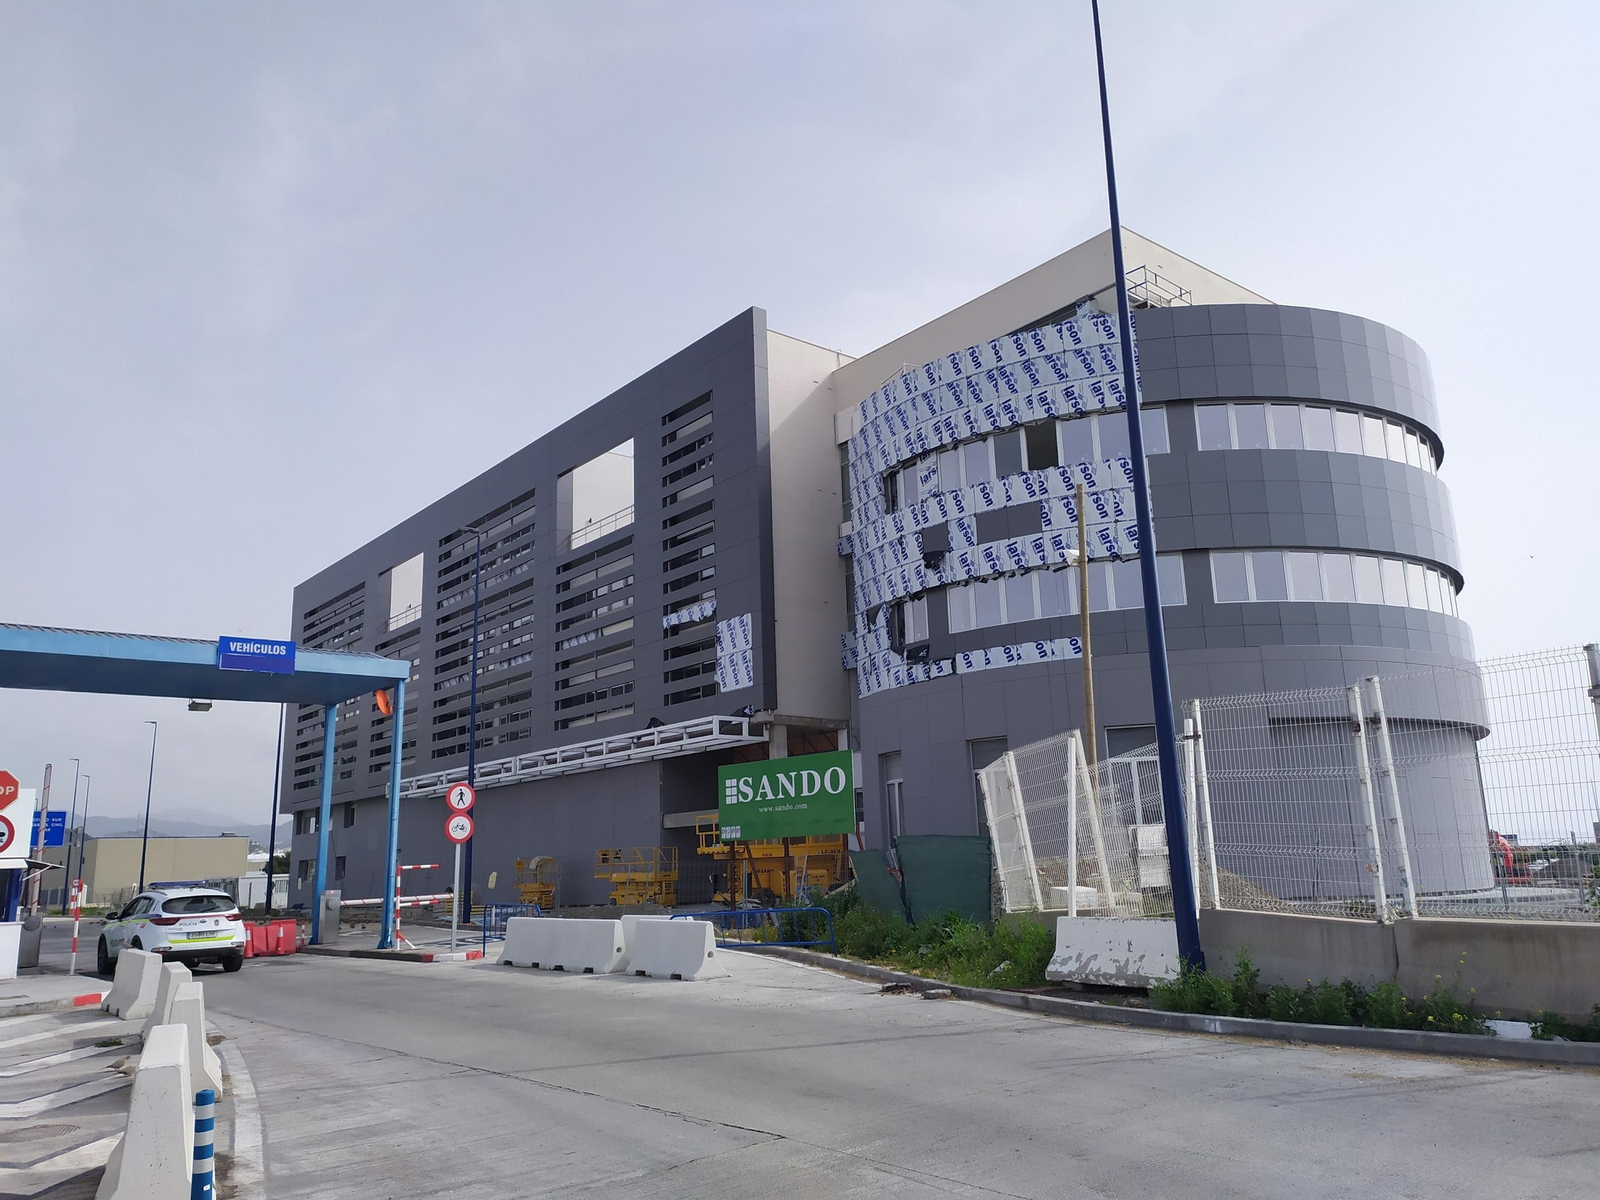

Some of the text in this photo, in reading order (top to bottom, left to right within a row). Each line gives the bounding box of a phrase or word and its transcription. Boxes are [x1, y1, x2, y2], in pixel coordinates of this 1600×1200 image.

[229, 642, 286, 656] VEHÍCULOS
[738, 766, 846, 802] SANDO
[758, 803, 808, 812] www.sando.com
